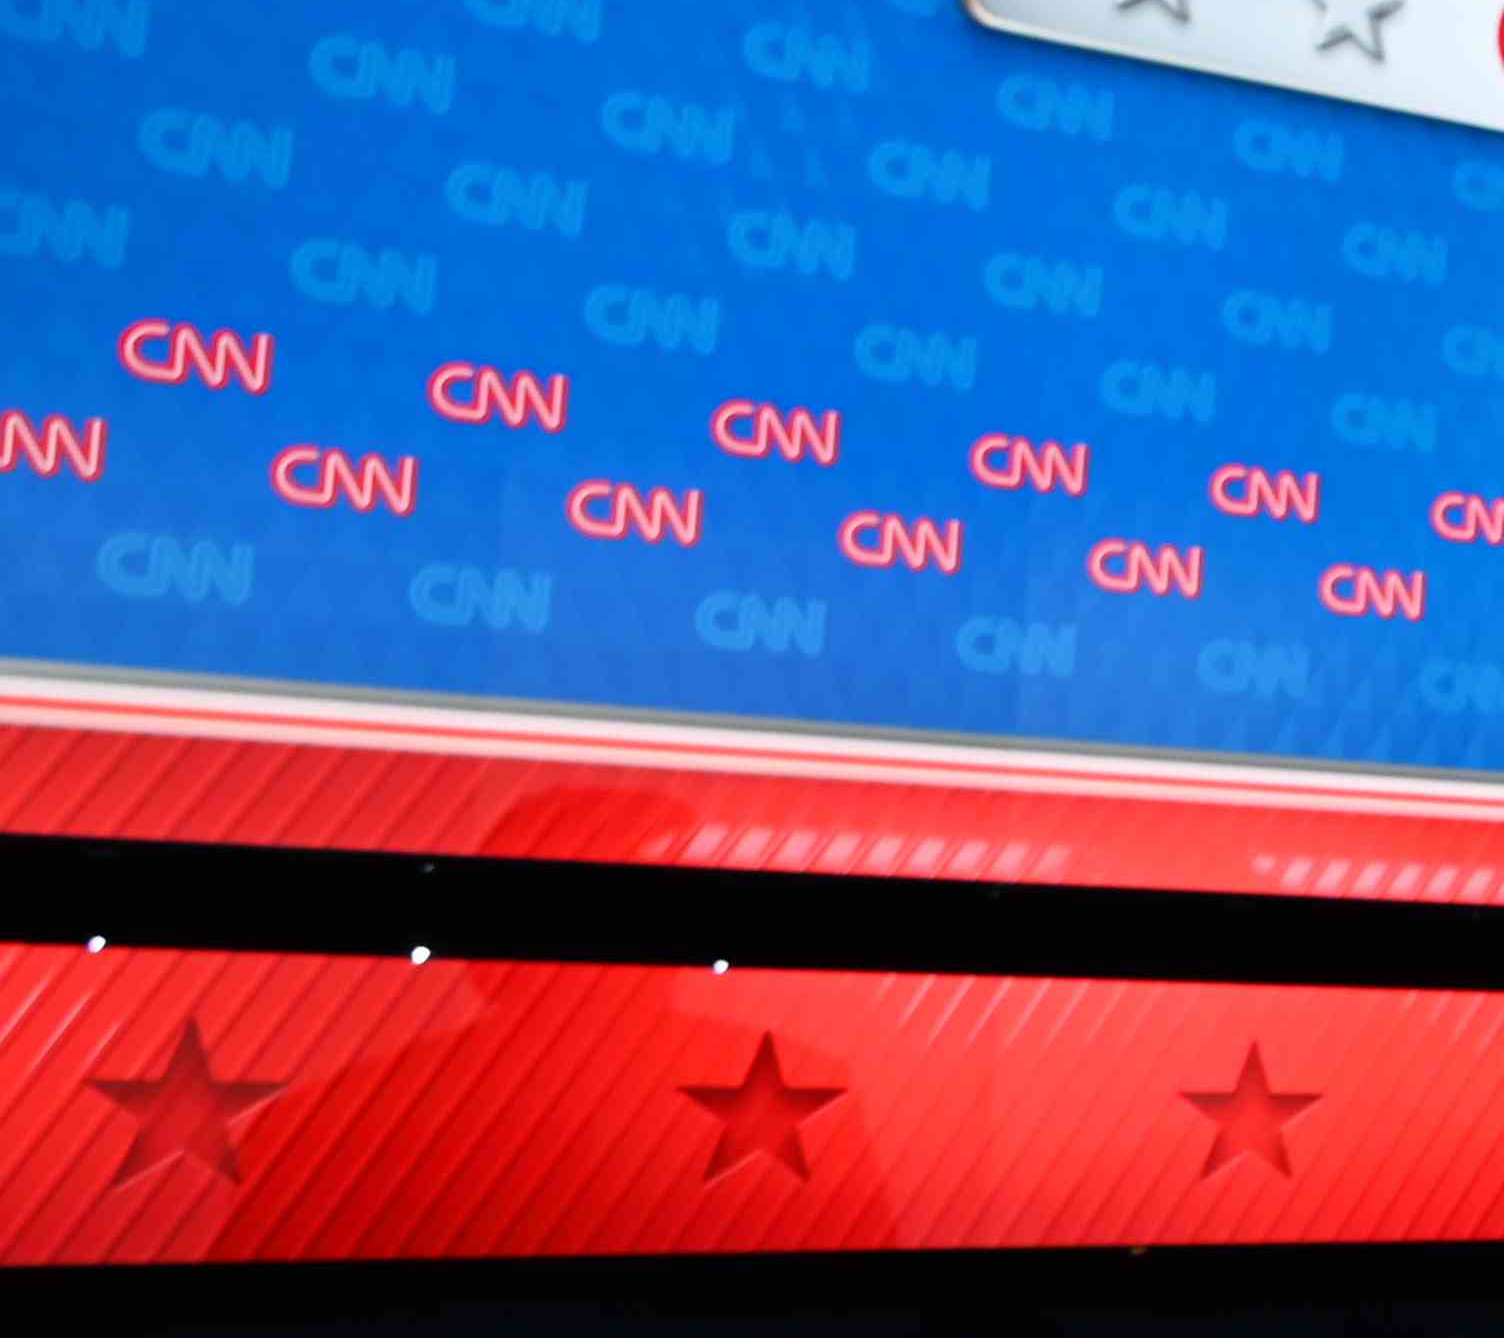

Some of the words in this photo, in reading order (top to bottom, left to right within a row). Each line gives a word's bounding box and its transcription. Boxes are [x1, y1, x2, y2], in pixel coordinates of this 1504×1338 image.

[118, 319, 274, 395] CNN
[427, 362, 569, 433] CNN
[0, 410, 108, 482] NN
[711, 400, 841, 466] CNN
[970, 434, 1089, 496] CNN
[270, 445, 419, 517] CNN
[566, 480, 704, 548] CNN
[1210, 464, 1321, 523] CNN
[838, 510, 964, 575] CNN
[1088, 539, 1204, 599] CNN
[1319, 564, 1427, 621] CNN
